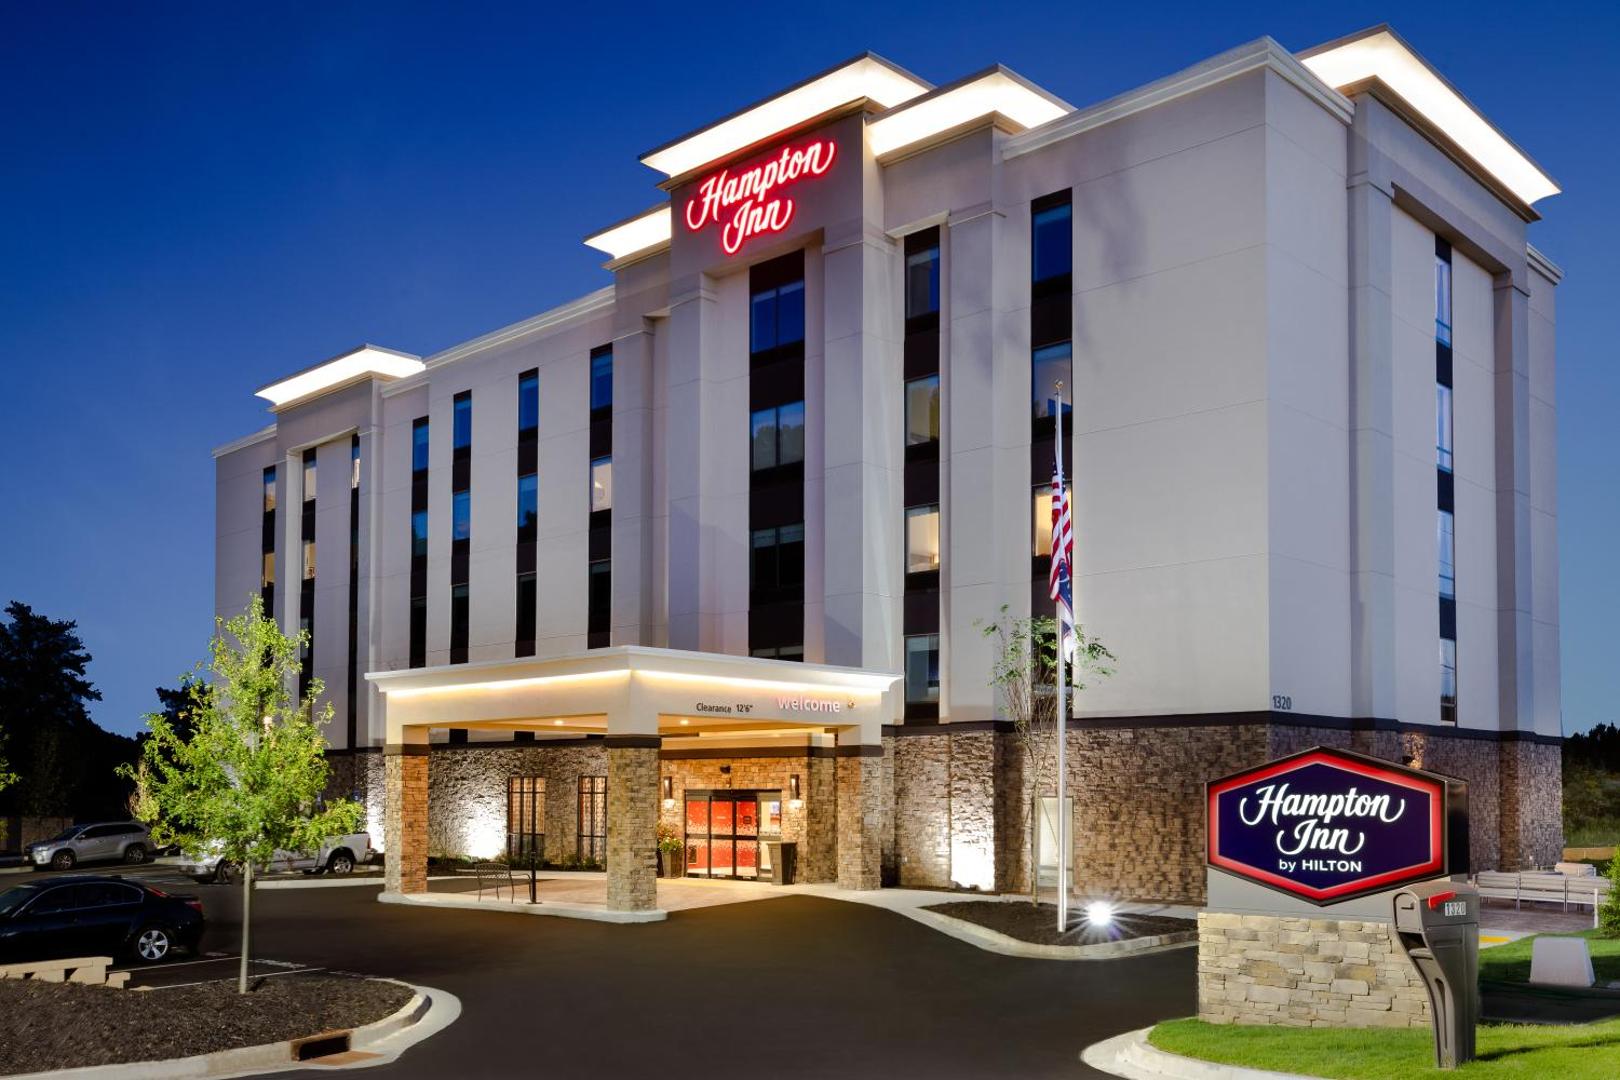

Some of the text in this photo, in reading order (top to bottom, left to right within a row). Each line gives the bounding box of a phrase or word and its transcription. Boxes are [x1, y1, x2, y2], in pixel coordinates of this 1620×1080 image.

[686, 141, 835, 230] Hampton
[723, 199, 793, 254] Inn
[696, 702, 732, 714] Clearance
[777, 696, 840, 713] welcome
[1272, 695, 1292, 710] 1320
[1239, 783, 1405, 826] Hampton
[1276, 818, 1365, 855] Inn
[1279, 859, 1362, 873] by HILTON
[1445, 902, 1466, 916] 1320
